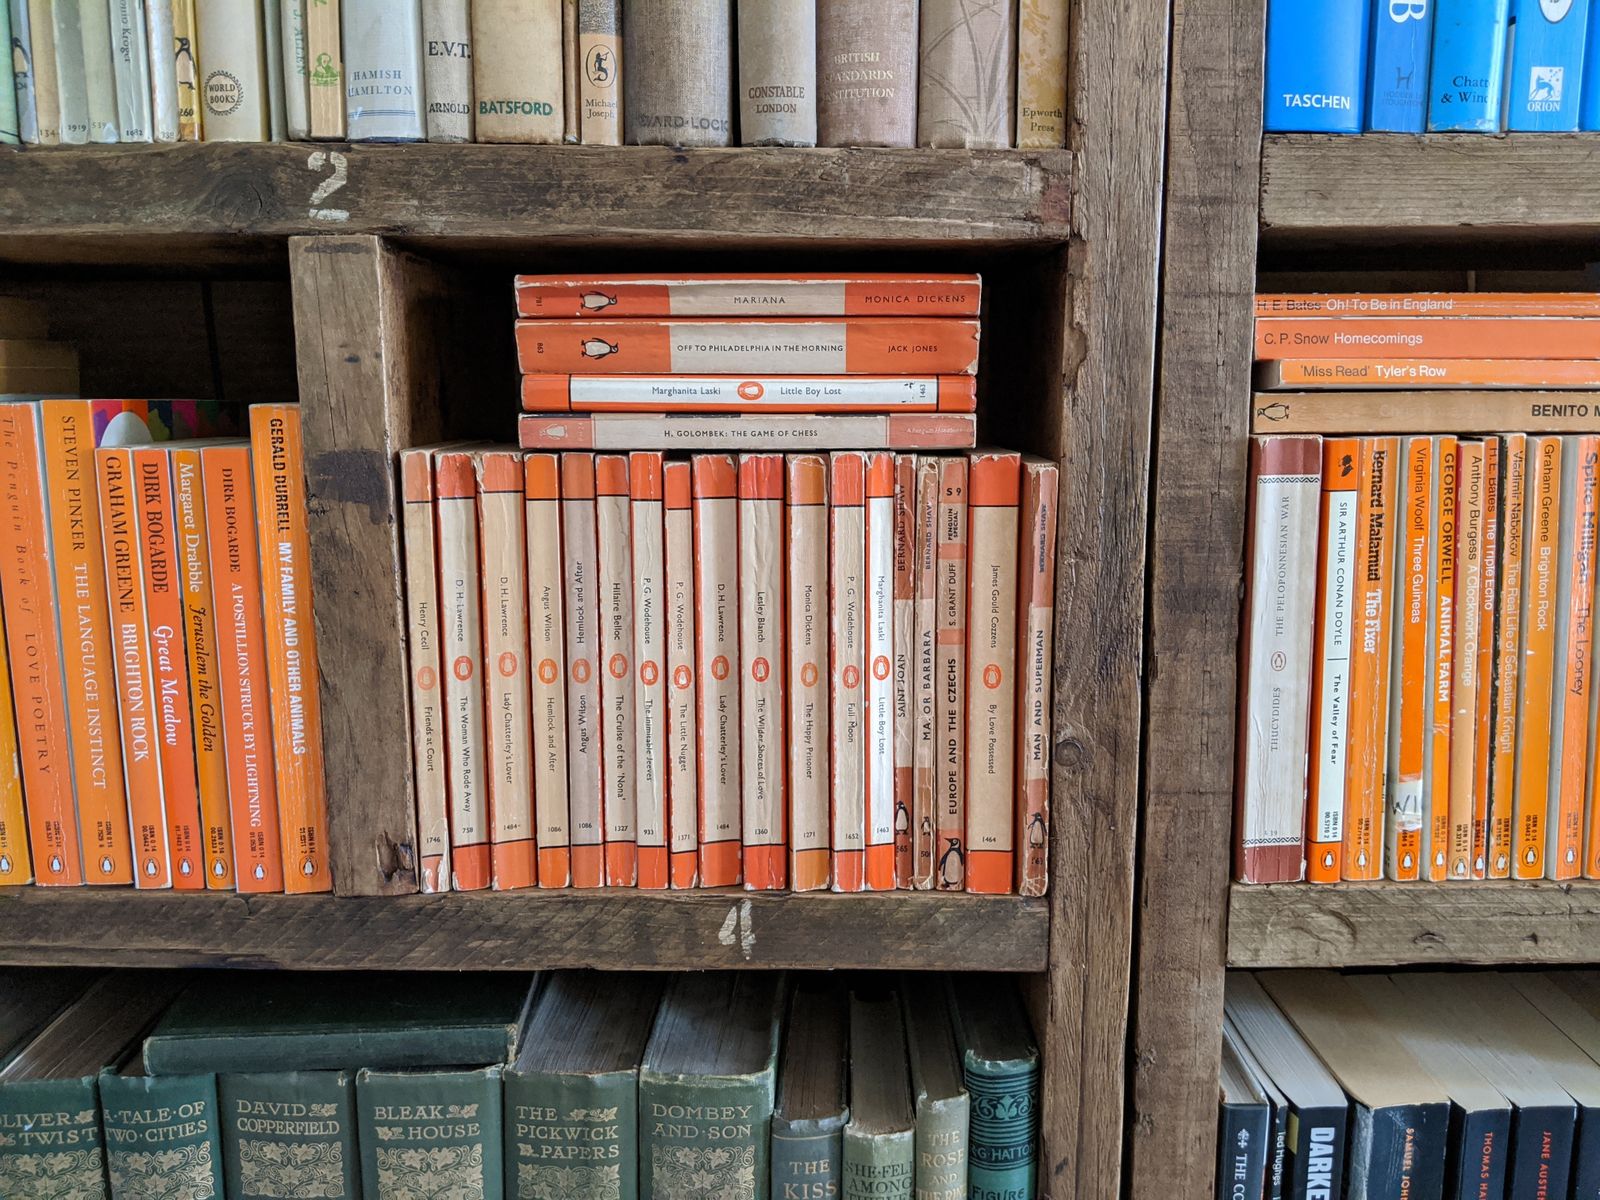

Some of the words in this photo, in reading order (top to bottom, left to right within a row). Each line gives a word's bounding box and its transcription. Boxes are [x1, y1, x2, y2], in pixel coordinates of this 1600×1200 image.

[428, 41, 471, 60] E.V.T.
[834, 52, 881, 64] BRITISH
[208, 84, 236, 94] WORLD
[353, 69, 401, 82] HAMISH
[748, 85, 806, 100] CONSTABLE
[209, 95, 236, 105] BOOKS
[428, 103, 470, 116] ARNOLD
[479, 101, 554, 116] BATSFORD
[585, 98, 617, 110] Michael
[587, 109, 616, 121] Joseph
[755, 102, 798, 115] LONDON
[1022, 106, 1063, 120] Epworth
[1283, 94, 1350, 110] TASCHEN
[1441, 93, 1453, 105] &
[1527, 101, 1560, 112] ORION
[1030, 122, 1055, 133] Press
[307, 151, 350, 222] 2
[733, 295, 787, 305] MARIANA
[864, 294, 911, 304] MONICA
[916, 294, 967, 304] DICKENS
[1403, 298, 1453, 313] England
[709, 344, 770, 353] PHILADELPHIA
[783, 344, 800, 353] THE
[801, 344, 844, 353] MORNING
[888, 344, 908, 353] JACK
[911, 344, 938, 353] JONES
[1294, 333, 1330, 345] Snow
[1333, 332, 1423, 347] Homecomings
[1375, 365, 1416, 379] Tyler's
[1419, 365, 1446, 377] Row
[652, 385, 698, 398] Marghanita
[700, 385, 721, 396] Laski
[780, 385, 803, 396] Little
[824, 385, 842, 396] Lost
[1531, 405, 1589, 418] BENITO
[62, 416, 80, 481] STEVEN
[270, 418, 287, 471] GERALD
[676, 429, 728, 438] GOLOMBEK:
[750, 429, 774, 438] GAME
[792, 429, 818, 438] CHESS
[142, 463, 162, 505] DIRK
[222, 468, 236, 502] DIRK
[1370, 450, 1386, 508] Bernard
[1413, 448, 1428, 493] Virginia
[1442, 453, 1455, 516] GEORGE
[1468, 455, 1482, 506] Anthony
[1541, 444, 1555, 494] Graham
[105, 456, 128, 535] GRAHAM
[177, 463, 197, 530] Margaret
[274, 475, 291, 533] DURRELL
[68, 488, 86, 551] PINKER
[1414, 495, 1426, 531] Woolf
[1509, 503, 1522, 557] Nabokov
[1540, 496, 1553, 542] Greene
[146, 510, 169, 593] BOGARDE
[226, 506, 241, 573] BOGARDE
[897, 521, 906, 572] BERNARD
[1337, 521, 1347, 564] ARTHUR
[1367, 513, 1385, 581] Malamud
[1466, 509, 1480, 560] Burgess
[185, 533, 202, 593] Drabble
[1276, 525, 1288, 612] PELOPONNESIAN
[1412, 536, 1425, 571] Three
[1441, 521, 1454, 585] ORWELL
[73, 564, 90, 598] THE
[113, 539, 135, 613] GREENE
[991, 564, 1001, 588] James
[1335, 567, 1346, 608] CONAN
[1536, 546, 1551, 598] Brighton
[281, 566, 297, 615] FAMILY
[542, 586, 552, 610] Angus
[612, 582, 622, 611] Hilaire
[876, 575, 886, 618] Marghanita
[949, 587, 957, 617] GRANT
[991, 590, 1000, 614] Gould
[1411, 574, 1424, 624] Guineas
[1465, 575, 1479, 640] Clockwork
[417, 602, 429, 627] Henry
[456, 605, 465, 642] Lawrence
[501, 599, 510, 637] Lawrence
[545, 613, 553, 642] Wilson
[613, 615, 622, 641] Belloc
[644, 598, 653, 645] Wodehouse
[676, 602, 685, 650] Wodehouse
[718, 605, 726, 642] Lawrence
[804, 615, 813, 646] Dickens
[847, 601, 855, 649] Wodehouse
[1333, 611, 1344, 646] DOYLE
[1439, 595, 1451, 659] ANIMAL
[1536, 600, 1549, 632] Rock
[153, 625, 175, 672] Great
[233, 594, 249, 676] POSTILLION
[990, 616, 999, 649] Cozzens
[1364, 619, 1380, 654] Fixer
[78, 605, 97, 701] LANGUAGE
[121, 624, 144, 712] BRIGHTON
[897, 654, 906, 684] JOAN
[922, 630, 931, 690] BARBARA
[1034, 629, 1044, 693] SUPERMAN
[286, 650, 301, 692] OTHER
[947, 658, 957, 704] CZECHS
[1439, 662, 1450, 702] FARM
[1503, 655, 1516, 713] Sebastian
[161, 678, 182, 746] Meadow
[240, 678, 254, 731] STRUCK
[547, 697, 557, 731] Hemlock
[578, 694, 587, 725] Wilson
[897, 686, 906, 718] SAINT
[1270, 686, 1281, 752] THUCYDIDES
[31, 696, 50, 774] POETRY
[289, 694, 306, 755] ANIMALS
[424, 706, 434, 735] Friends
[461, 714, 469, 746] Woman
[504, 713, 514, 760] Chatterley's
[616, 712, 625, 741] Cruise
[719, 714, 729, 761] Chatterley's
[87, 708, 107, 789] INSTINCT
[131, 716, 149, 763] ROCK
[988, 738, 997, 775] Possessed
[427, 748, 435, 772] Court
[805, 747, 813, 779] Prisoner
[246, 754, 262, 827] LIGHTNING
[947, 771, 957, 815] EUROPE
[118, 1107, 174, 1124] TALE
[236, 1099, 307, 1117] DAVID
[374, 1105, 443, 1121] BLEAK
[515, 1105, 557, 1122] THE
[651, 1104, 753, 1121] DOMBEY
[19, 1127, 98, 1147] TWIST
[144, 1119, 208, 1143] CITIES
[237, 1117, 340, 1136] COPPERFIELD
[408, 1123, 481, 1140] HOUSE
[516, 1124, 619, 1141] PICKWICK
[651, 1123, 699, 1139] AND
[706, 1123, 753, 1140] SON
[927, 1131, 961, 1147] THE
[540, 1143, 621, 1160] PAPERS
[921, 1149, 964, 1168] ROSE
[1402, 1128, 1415, 1171] SAMUEL
[1480, 1131, 1494, 1179] THOMAS
[1541, 1131, 1552, 1159] JANE
[788, 1158, 831, 1176] THE
[1234, 1153, 1248, 1181] THE
[1272, 1150, 1285, 1186] Hughes
[783, 1181, 838, 1200] KISS
[849, 1176, 913, 1195] AMONG
[971, 1184, 1025, 1200] FIGURE
